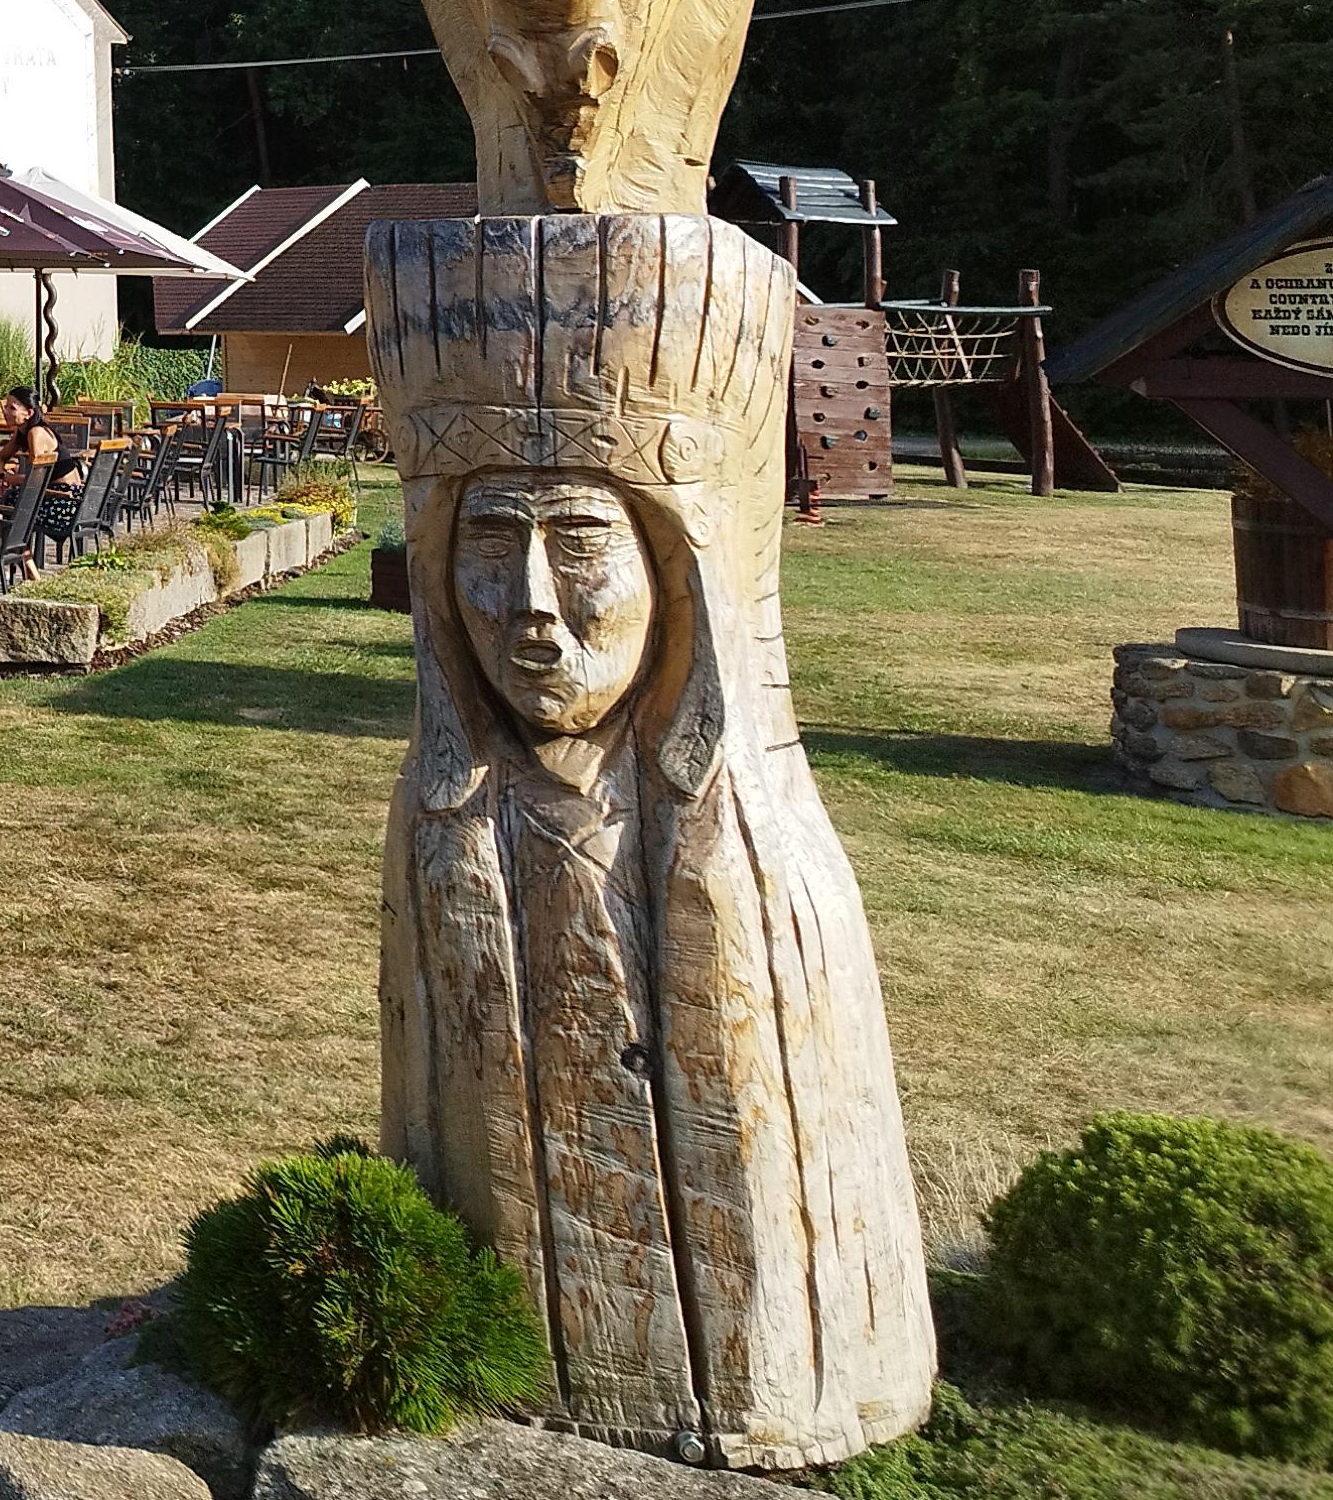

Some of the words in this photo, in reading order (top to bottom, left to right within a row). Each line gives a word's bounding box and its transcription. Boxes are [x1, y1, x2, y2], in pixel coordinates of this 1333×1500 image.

[1250, 279, 1261, 289] A
[1251, 307, 1302, 320] KAŽDÝ
[1269, 325, 1311, 336] NEBO
